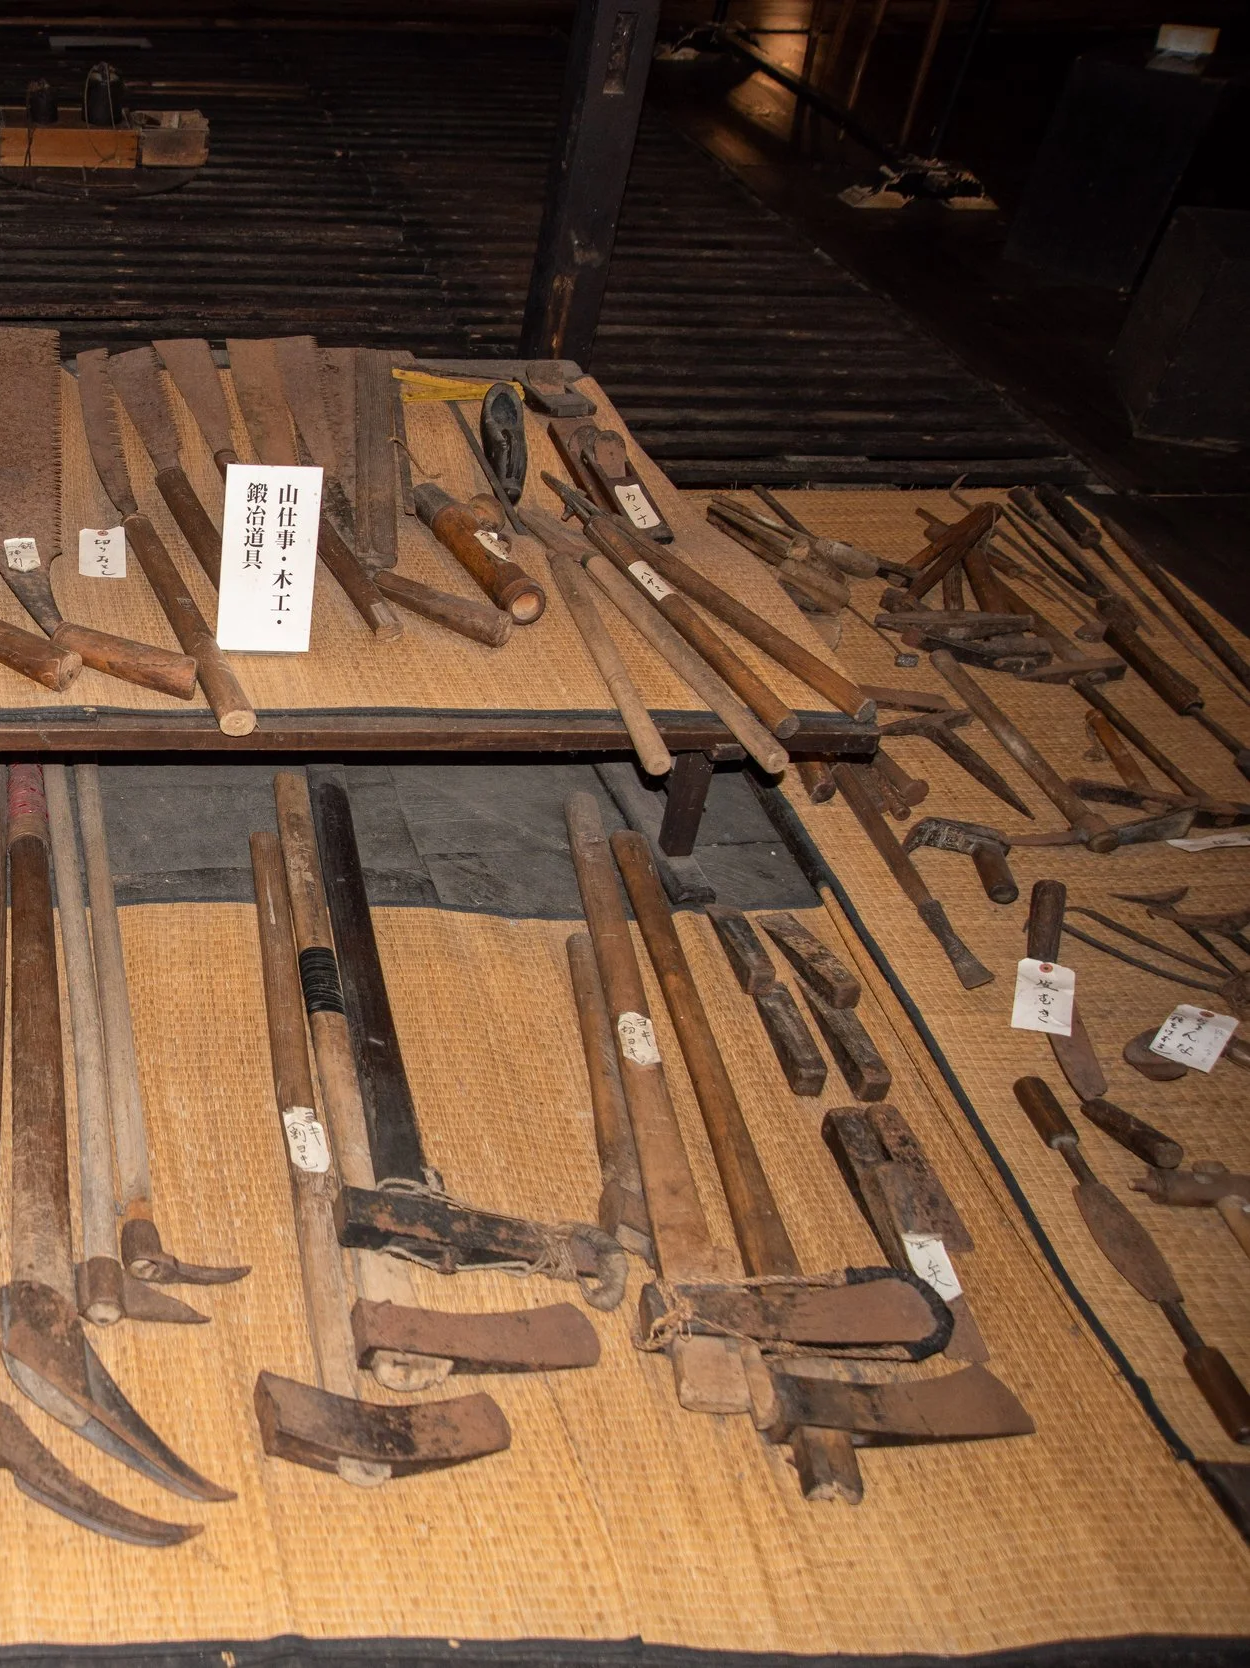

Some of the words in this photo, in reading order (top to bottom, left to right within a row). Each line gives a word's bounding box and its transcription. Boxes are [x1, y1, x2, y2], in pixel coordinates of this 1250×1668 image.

[242, 482, 268, 570] 鍛冶道具
[626, 492, 647, 525] カンナ
[270, 483, 299, 625] 山仕事・木工・
[641, 572, 665, 592] ハサミ
